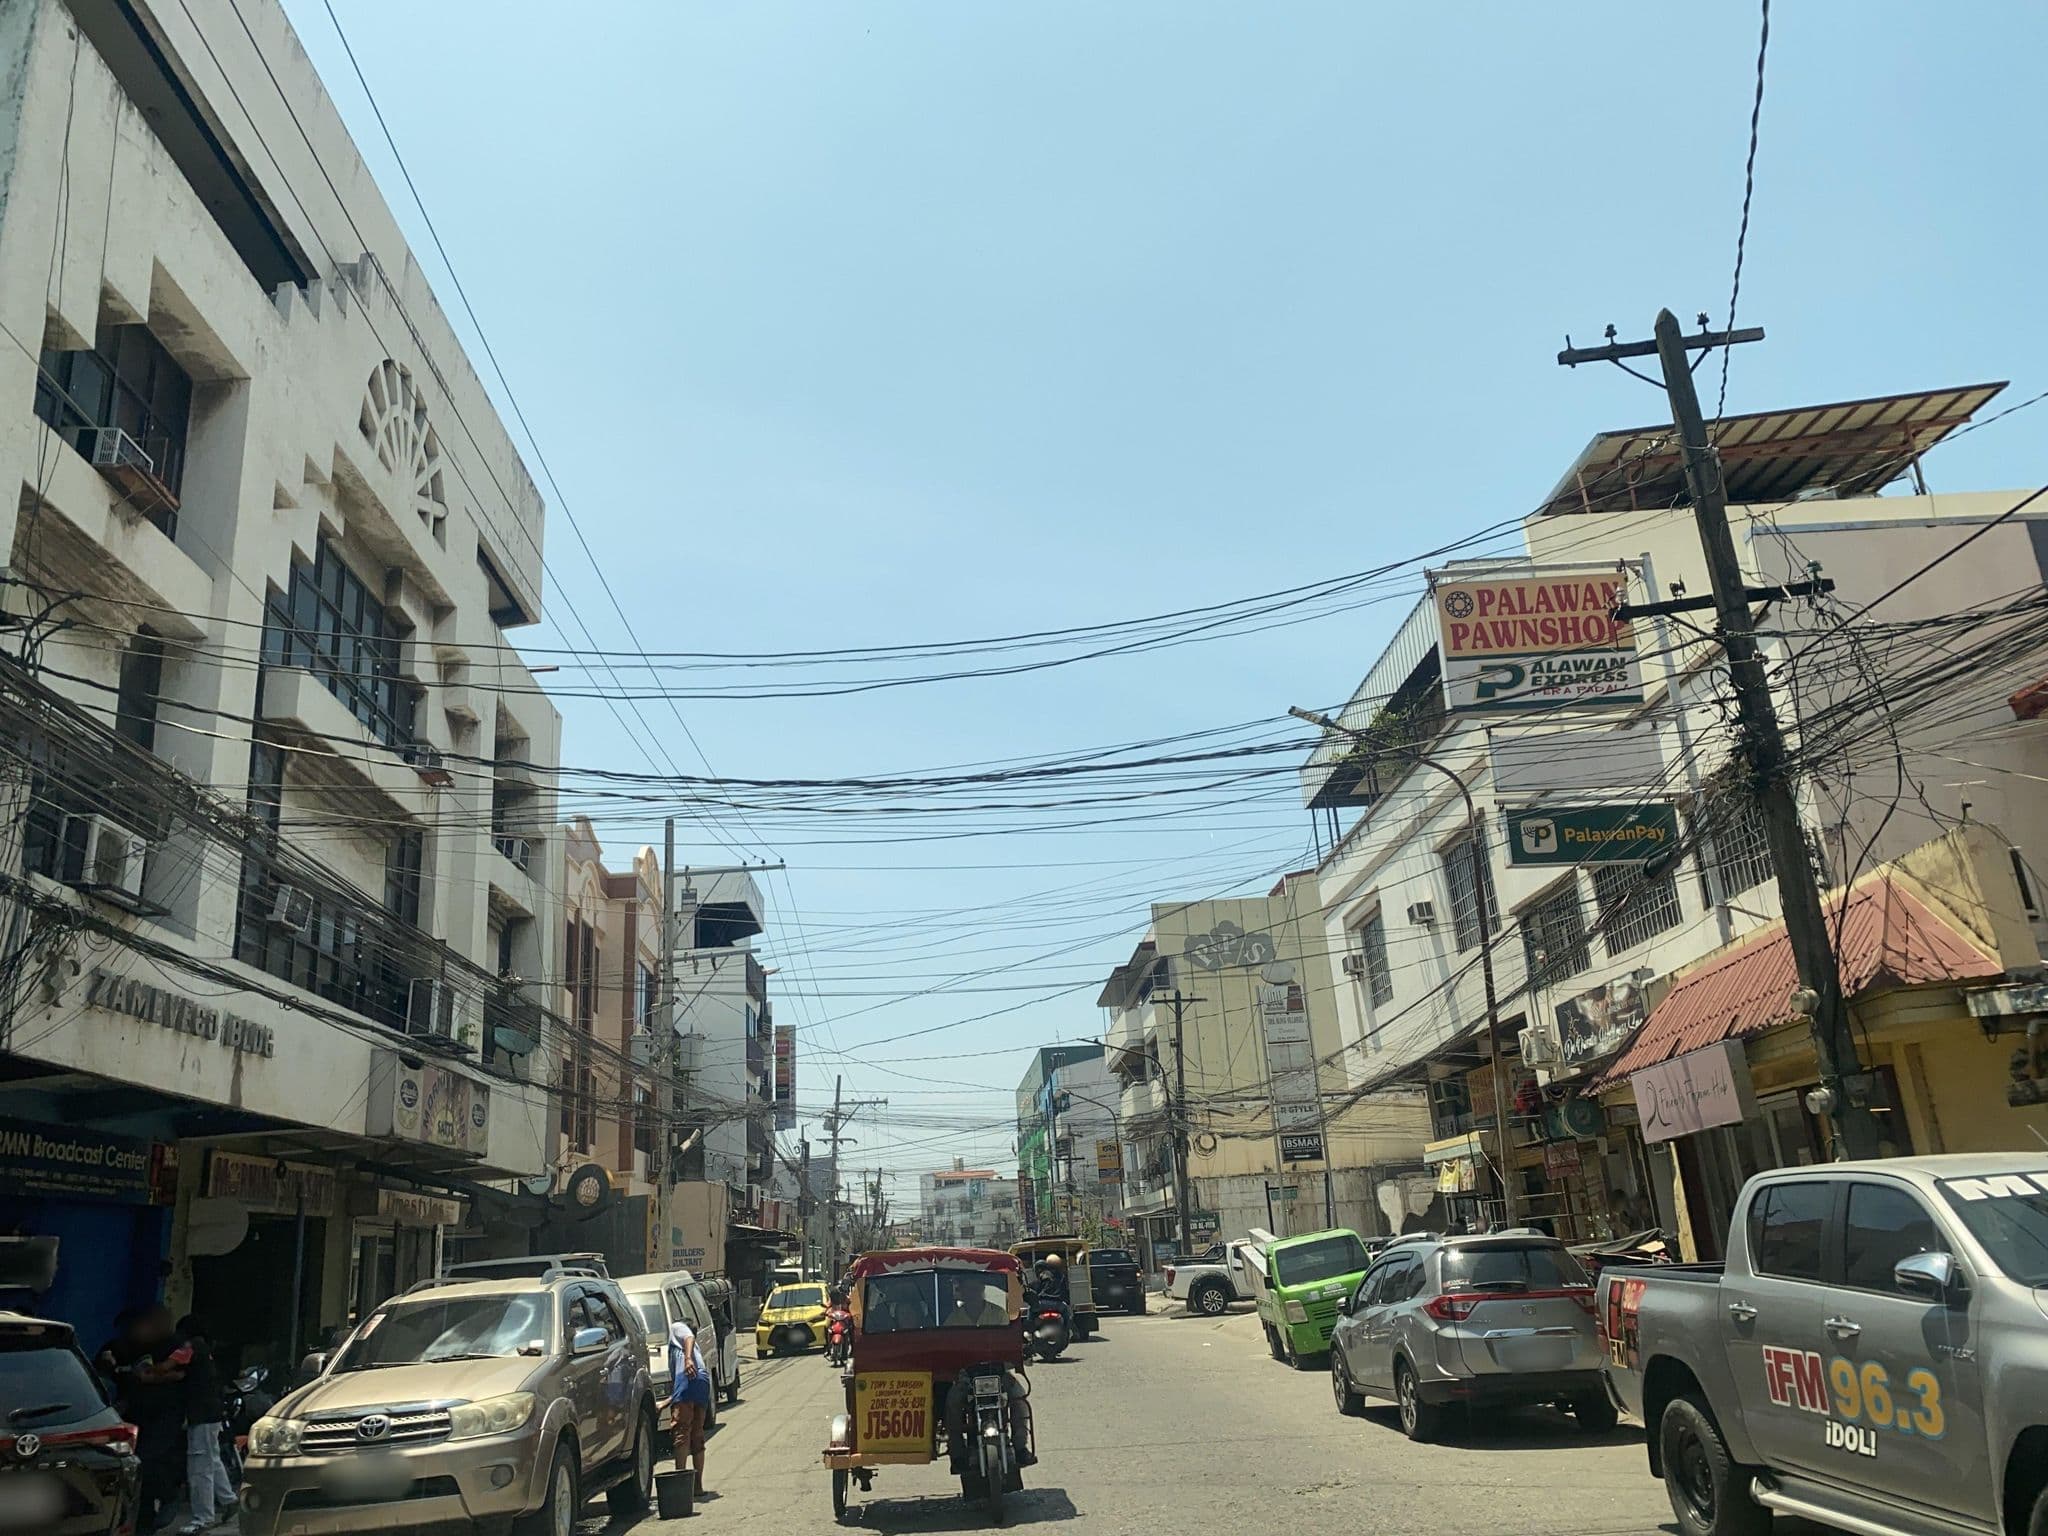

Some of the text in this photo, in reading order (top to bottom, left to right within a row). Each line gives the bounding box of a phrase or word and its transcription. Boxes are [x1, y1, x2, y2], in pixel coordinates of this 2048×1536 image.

[1476, 581, 1620, 617] PALAWAN
[1450, 614, 1625, 650] PAWNSHOP
[1531, 671, 1628, 687] EXPRESS
[1564, 825, 1666, 842] PalawanPay
[33, 1134, 104, 1165] Broadcast
[105, 1145, 147, 1171] Center
[1944, 1173, 2048, 1200] M
[1763, 1345, 1946, 1439] iFM 96.3
